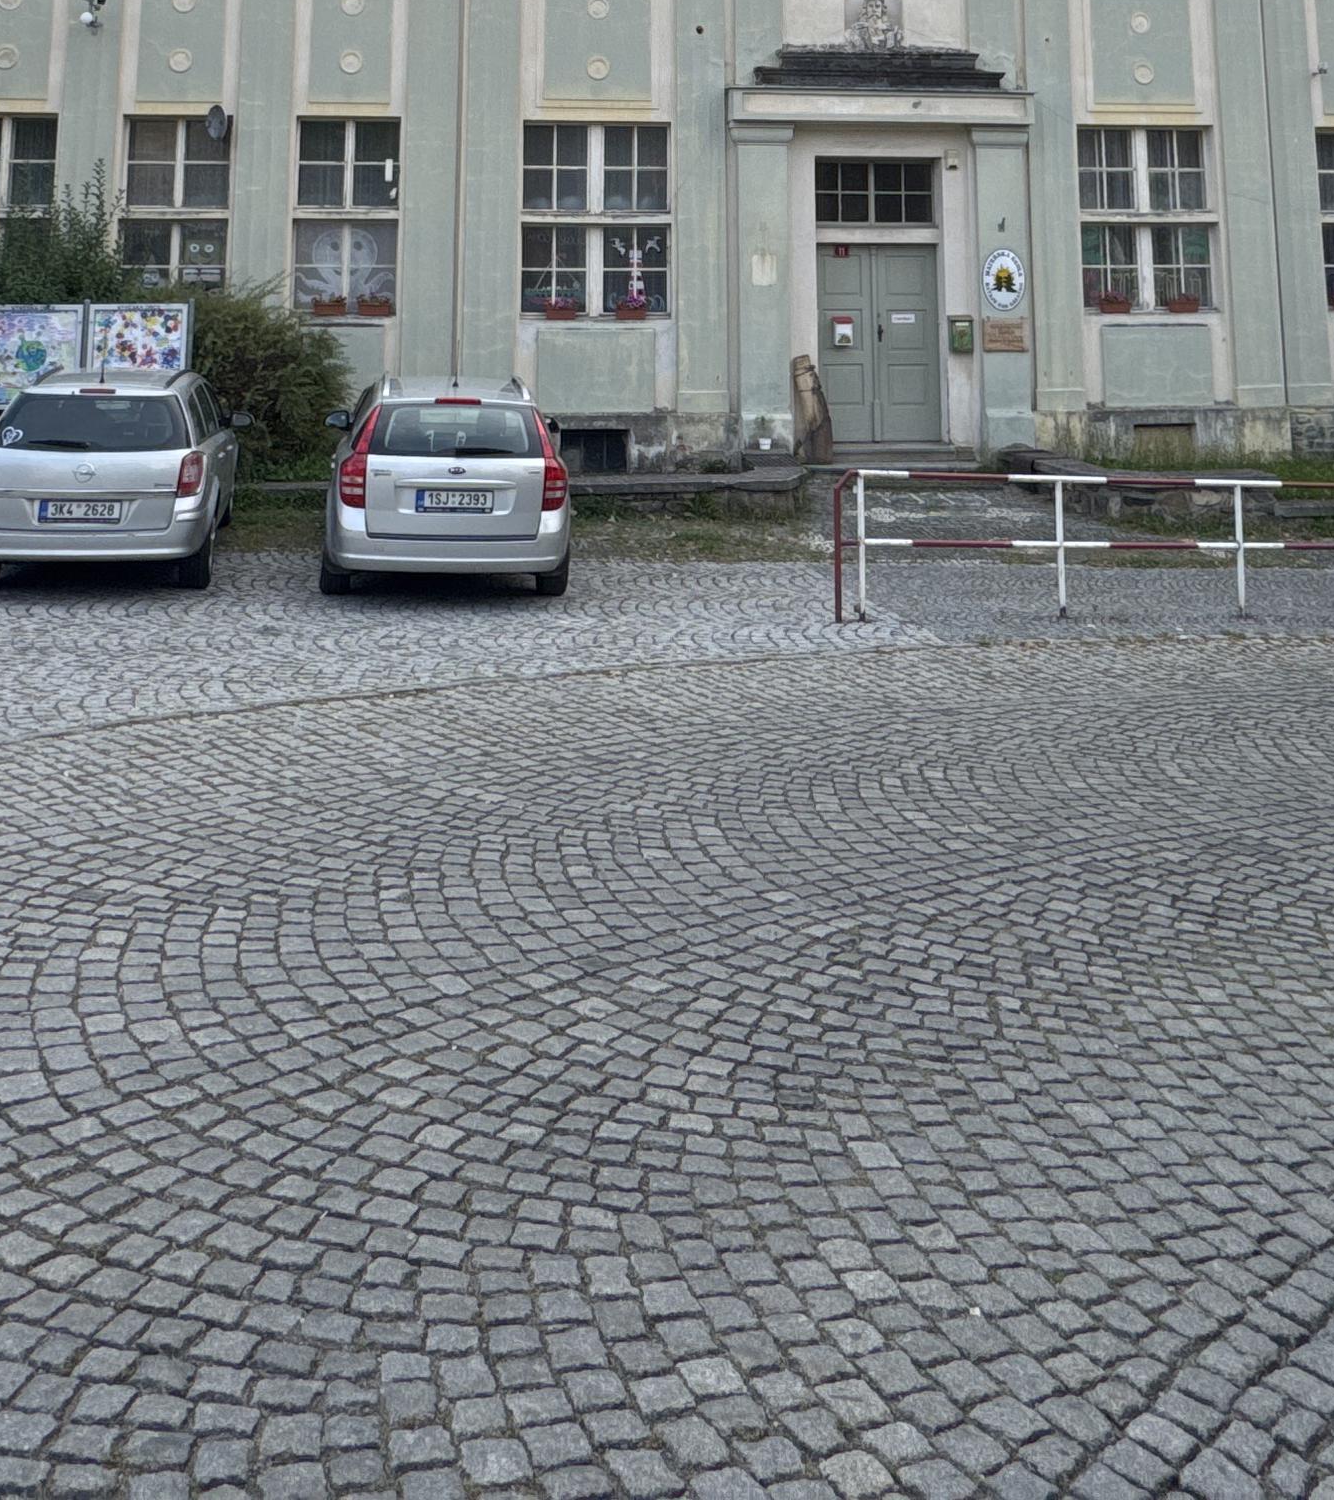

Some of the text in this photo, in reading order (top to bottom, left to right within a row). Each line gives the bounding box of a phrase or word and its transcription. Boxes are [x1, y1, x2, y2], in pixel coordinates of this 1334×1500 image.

[428, 492, 487, 507] 1SJ 2393
[50, 502, 115, 517] 3K4 2628
